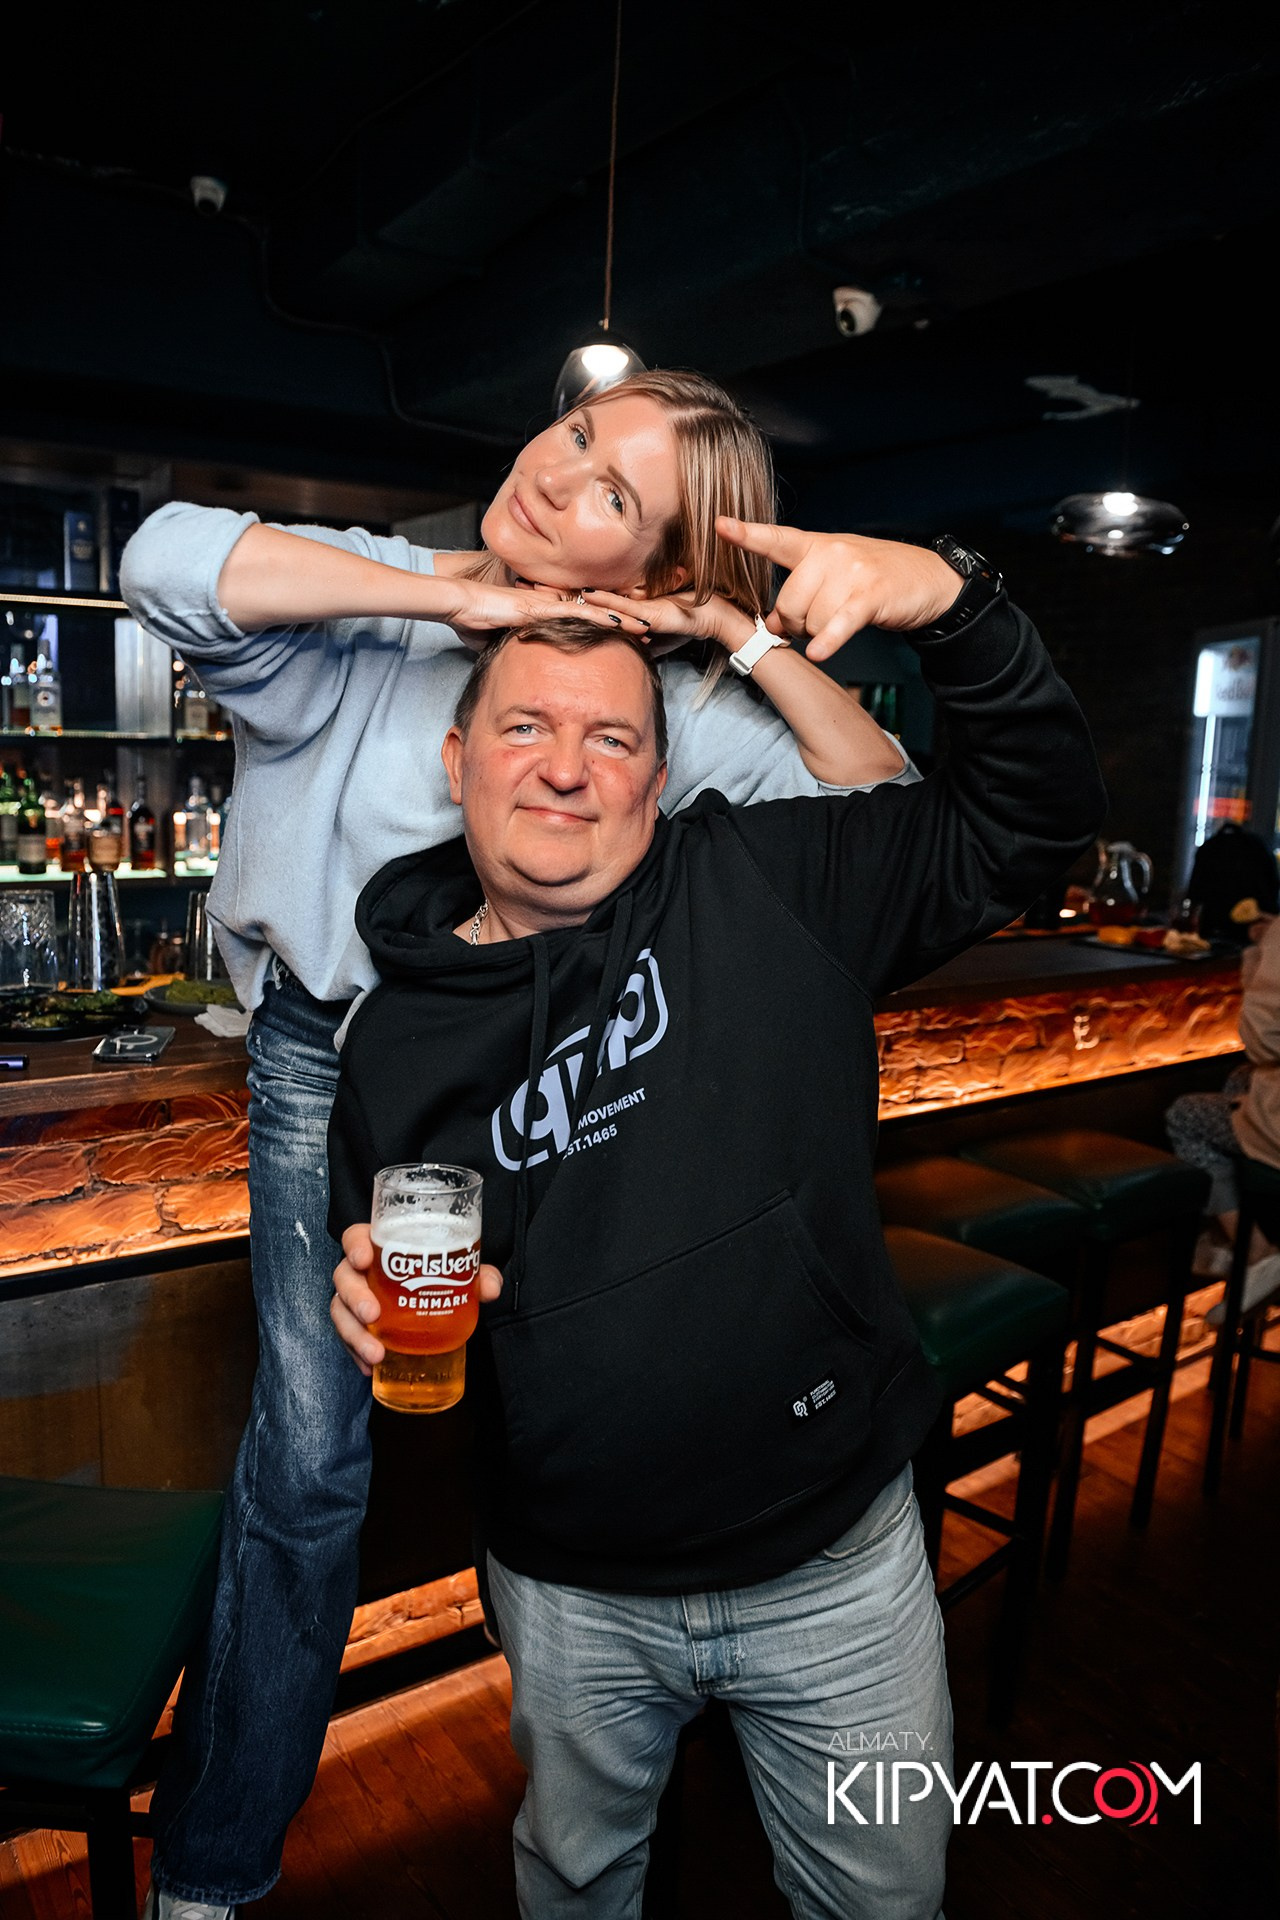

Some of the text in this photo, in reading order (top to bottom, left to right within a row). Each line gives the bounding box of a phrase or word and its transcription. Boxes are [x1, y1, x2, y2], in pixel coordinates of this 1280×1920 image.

[577, 1087, 646, 1130] MOVEMENT
[381, 1240, 480, 1287] Carlsberg
[398, 1293, 469, 1309] DENMARK
